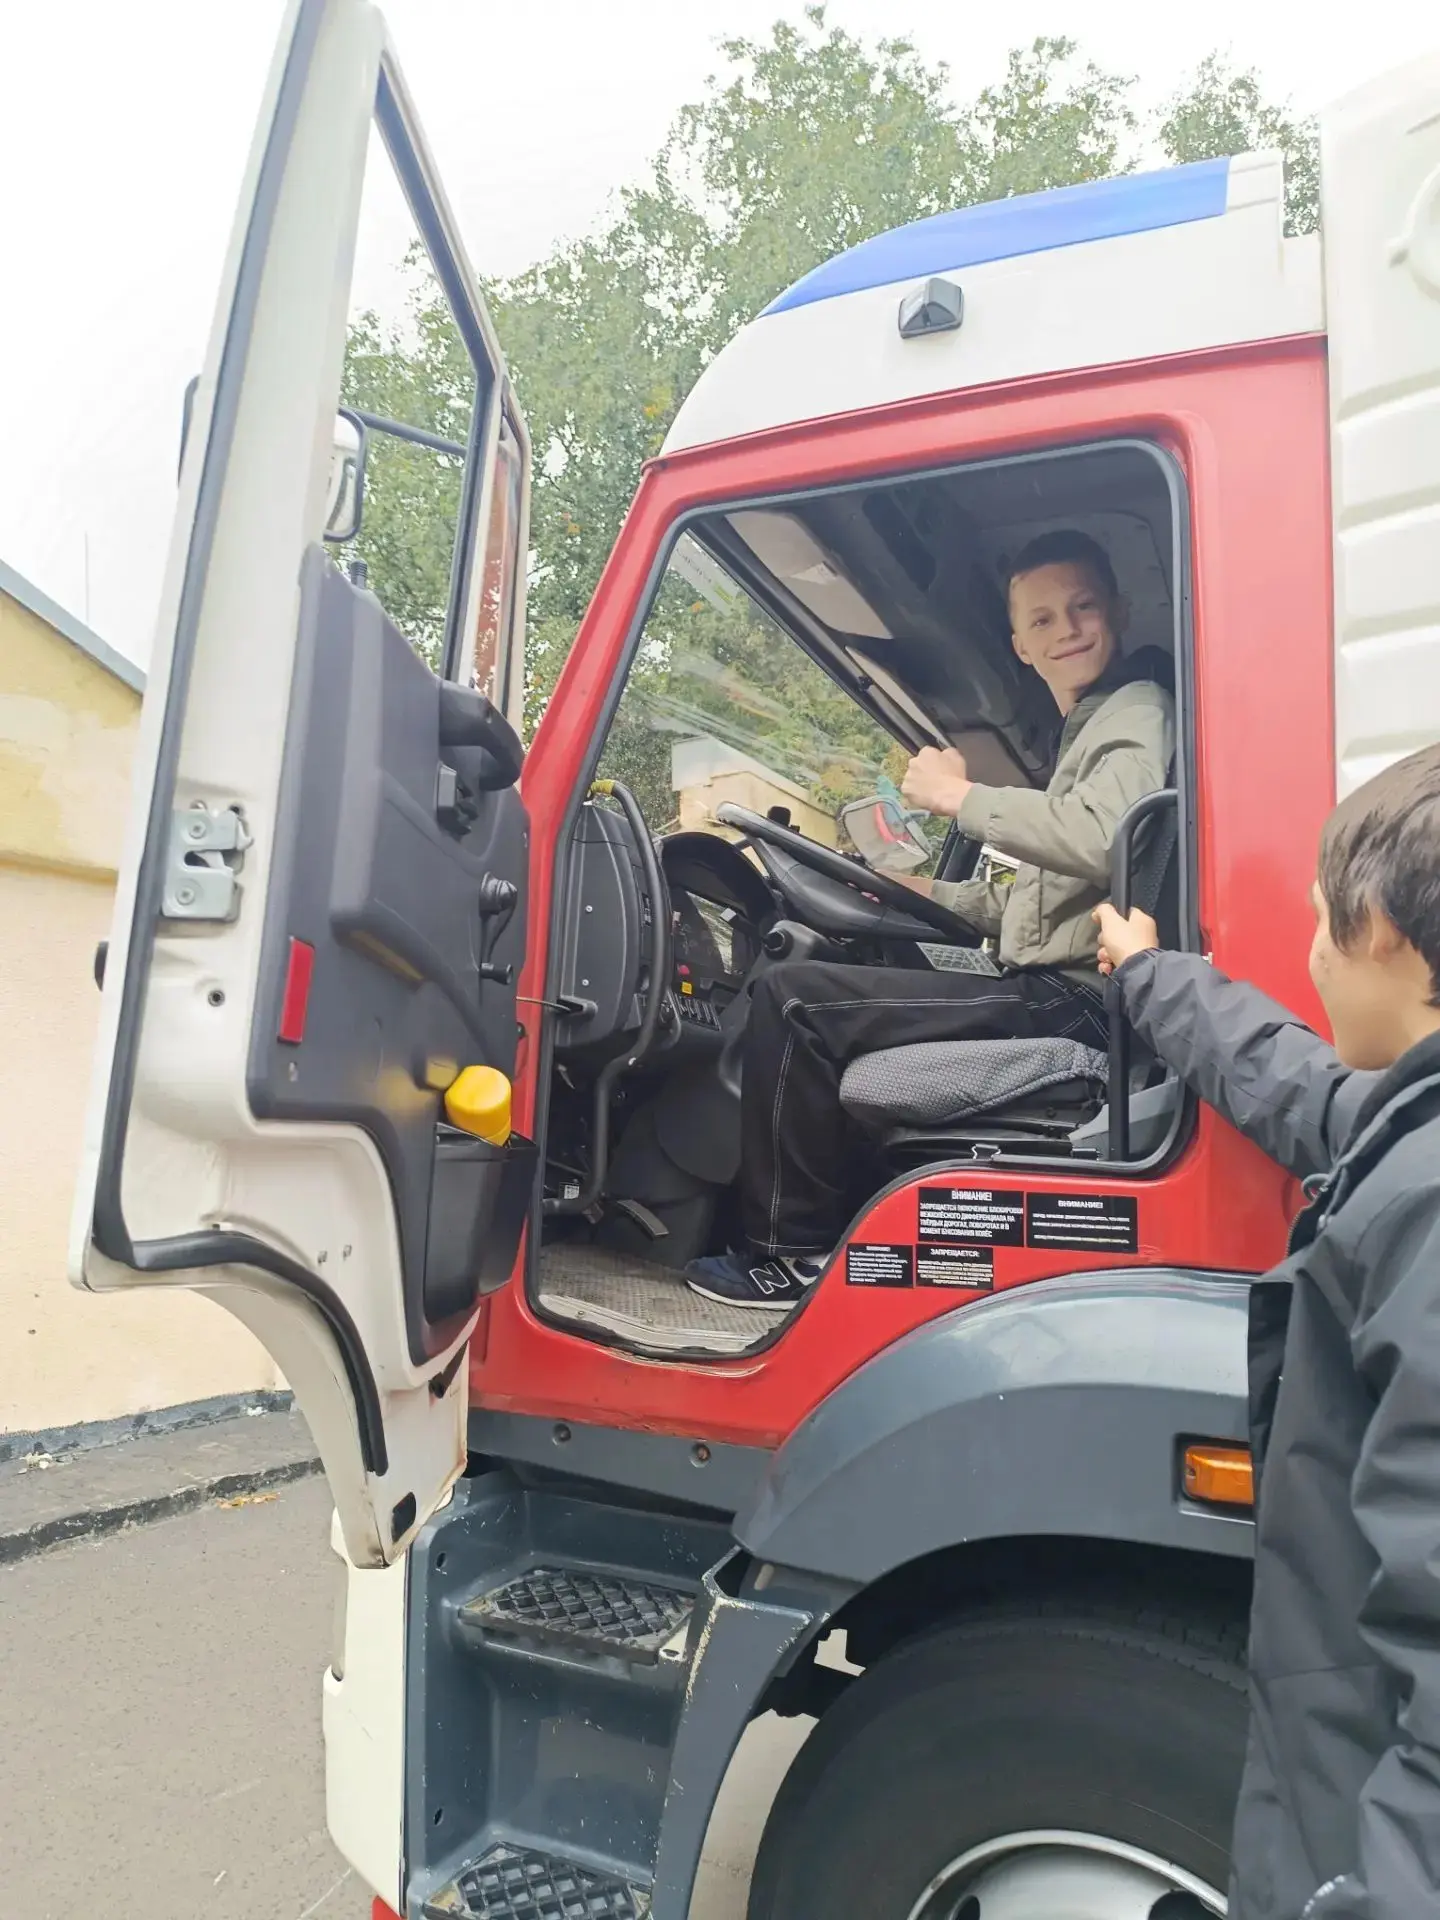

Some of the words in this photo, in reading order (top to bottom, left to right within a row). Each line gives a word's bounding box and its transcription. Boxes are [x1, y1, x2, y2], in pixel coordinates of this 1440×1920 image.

[951, 1190, 992, 1201] ВНИМАНИЕ!
[1058, 1200, 1104, 1209] ВНИМАНИЕ!
[749, 1262, 791, 1295] N
